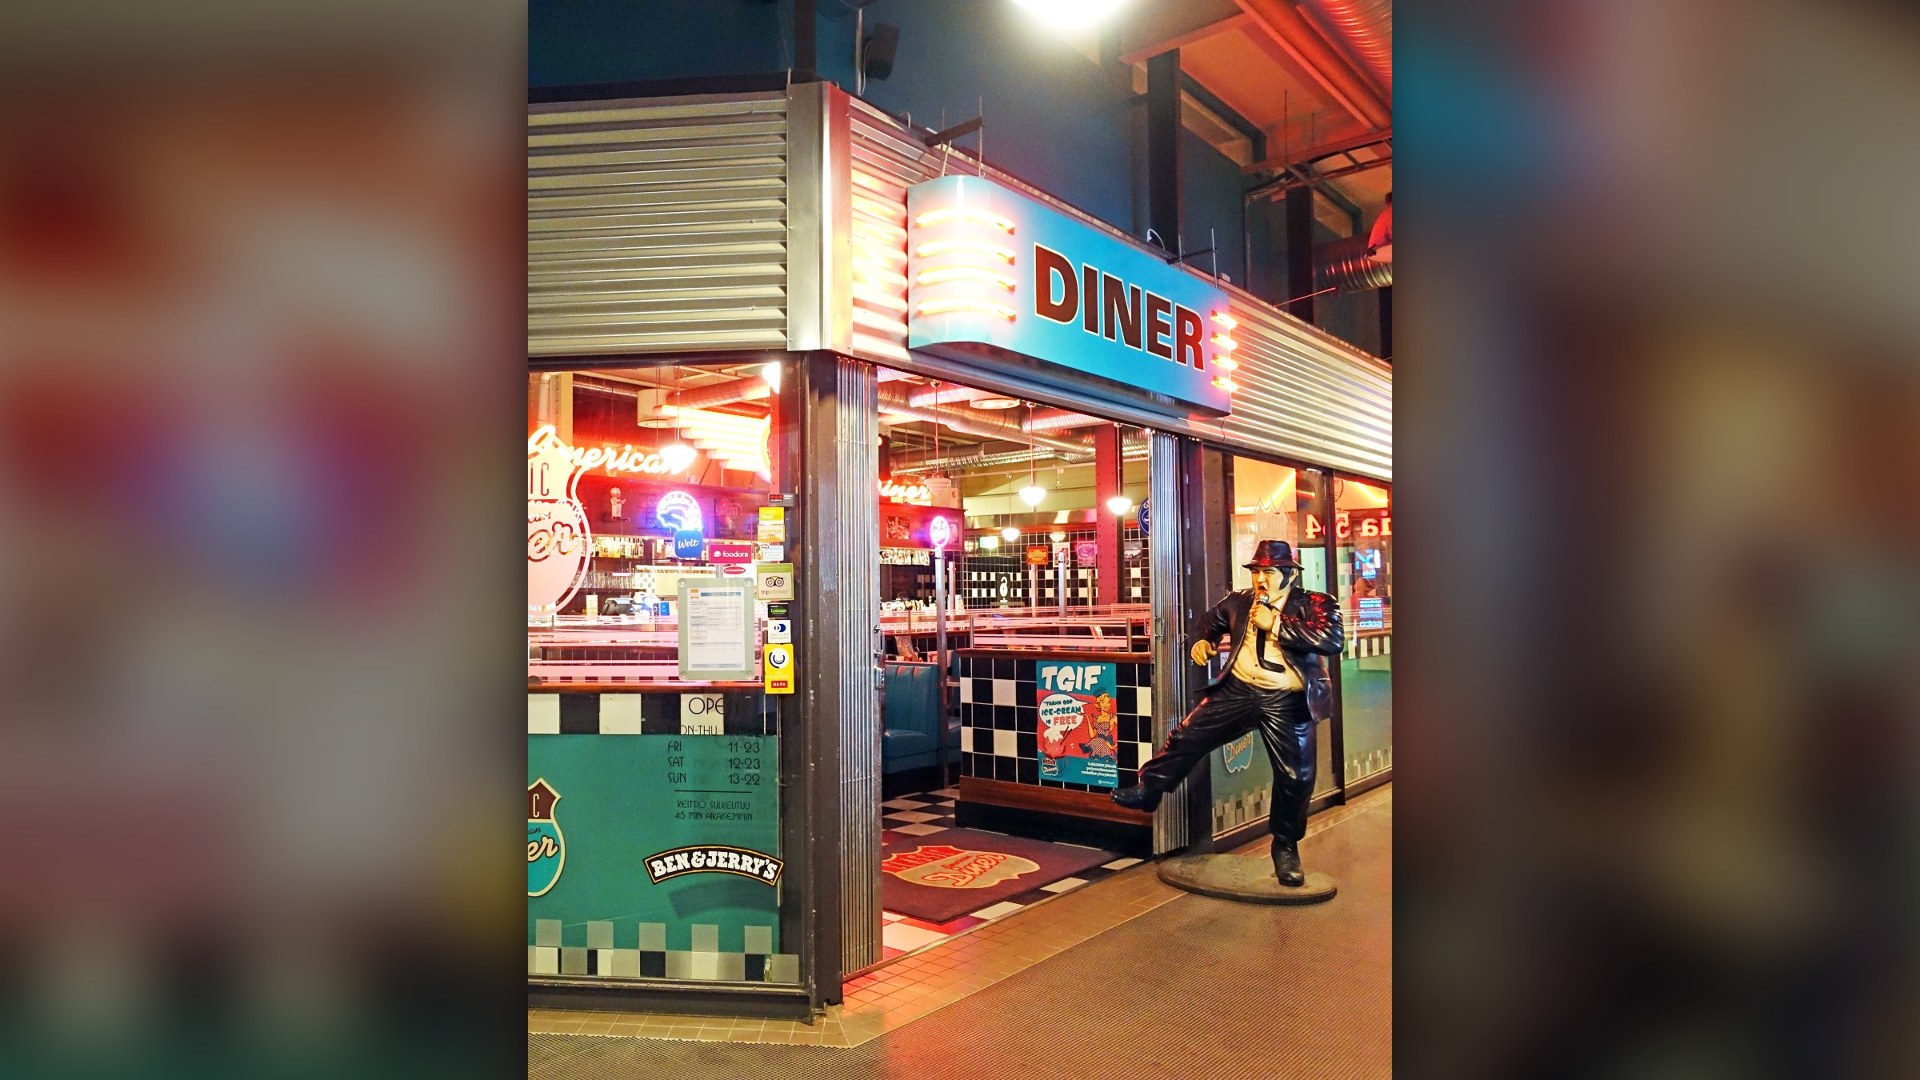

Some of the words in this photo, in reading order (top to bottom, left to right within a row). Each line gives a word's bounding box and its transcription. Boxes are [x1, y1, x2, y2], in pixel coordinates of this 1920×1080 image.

[1034, 242, 1205, 372] DINER
[678, 539, 699, 550] Wolt
[1042, 666, 1101, 691] TGIF
[1042, 706, 1081, 716] ICE-CREAM
[1053, 715, 1077, 725] FREE
[668, 741, 682, 752] FRI
[728, 742, 760, 753] 11-23
[668, 756, 684, 767] SAT
[728, 758, 760, 769] 12-23
[668, 772, 686, 783] SUN
[728, 774, 760, 785] 13-22
[689, 812, 702, 820] MIN
[921, 854, 1007, 887] Diner
